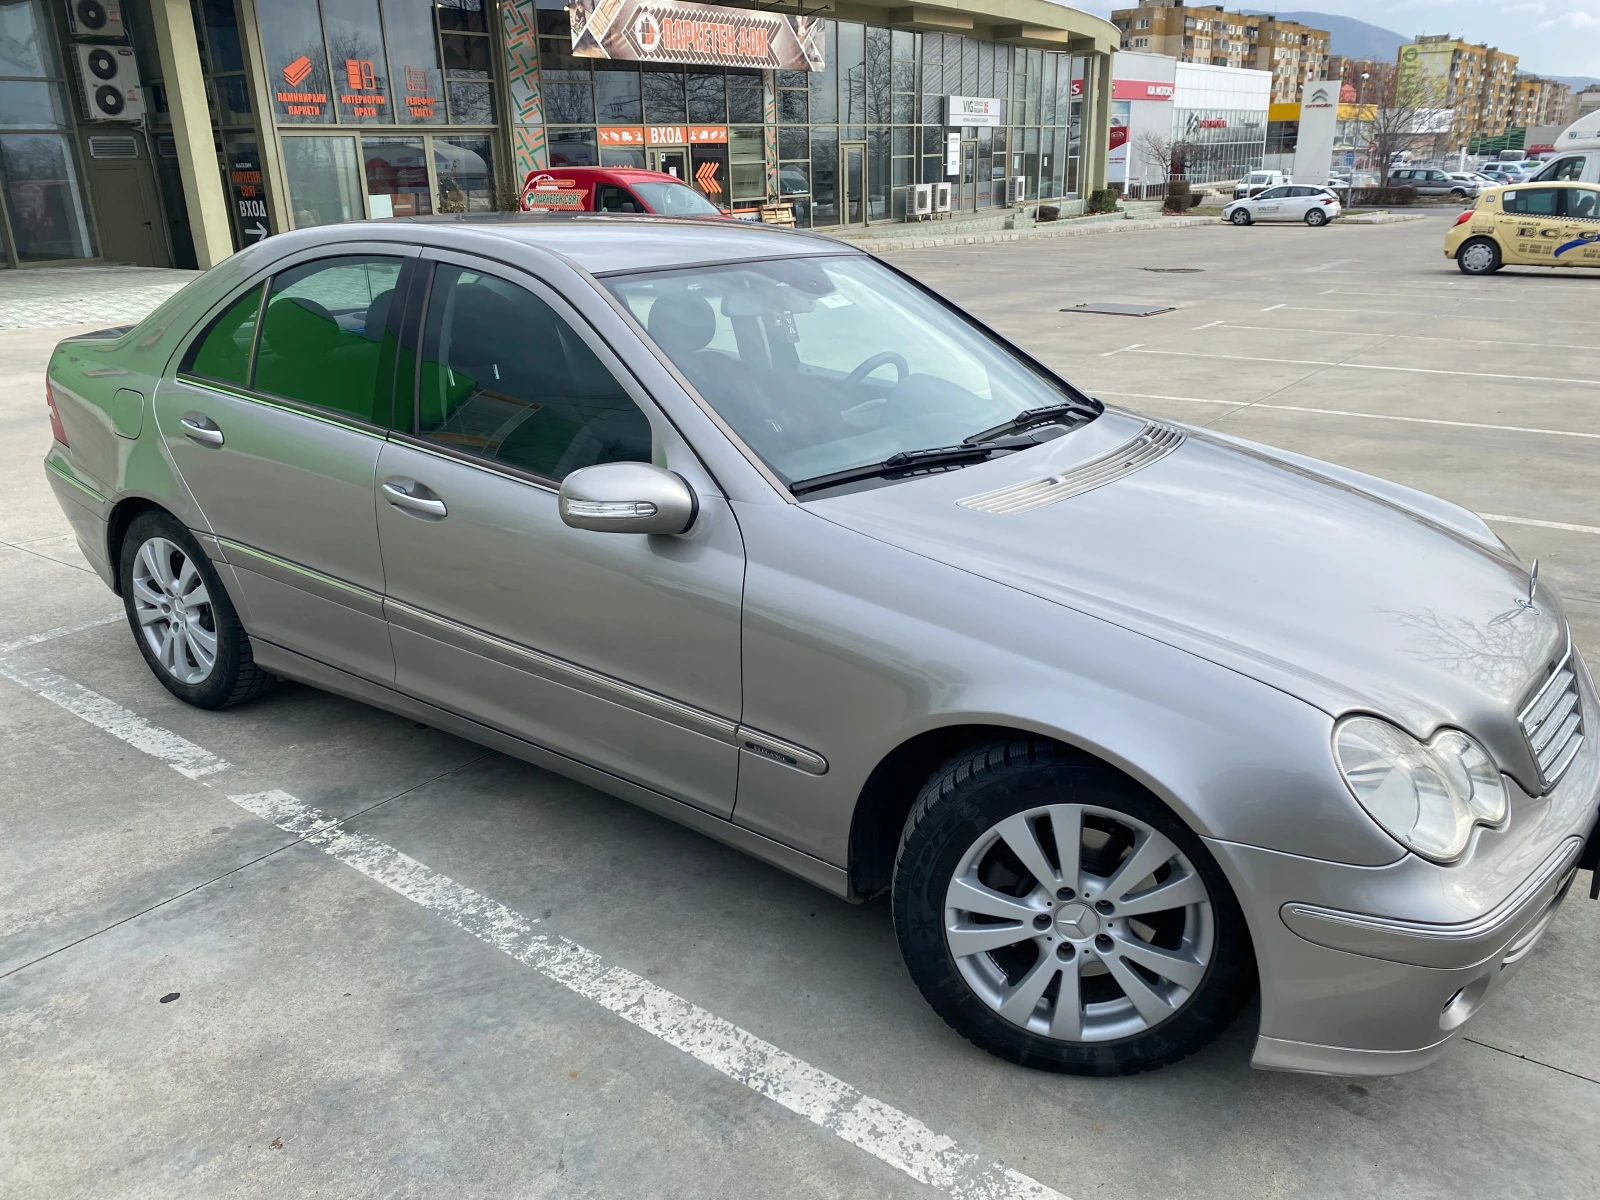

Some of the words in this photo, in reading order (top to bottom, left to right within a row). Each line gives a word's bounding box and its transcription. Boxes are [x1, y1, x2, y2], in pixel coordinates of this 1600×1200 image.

[663, 18, 736, 55] ПАРКЕТЕН
[738, 26, 769, 57] ДОМ
[277, 92, 327, 103] ЛАМИНИРАНИ
[340, 94, 386, 104] ИНТЕРИОРНИ
[288, 105, 320, 115] ПАРКЕТИ
[353, 107, 377, 116] ВРАТИ
[963, 101, 974, 113] VIG
[650, 127, 682, 144] ВХОД
[535, 193, 563, 204] ПАРКЕТЕН
[239, 200, 267, 217] ВХОД
